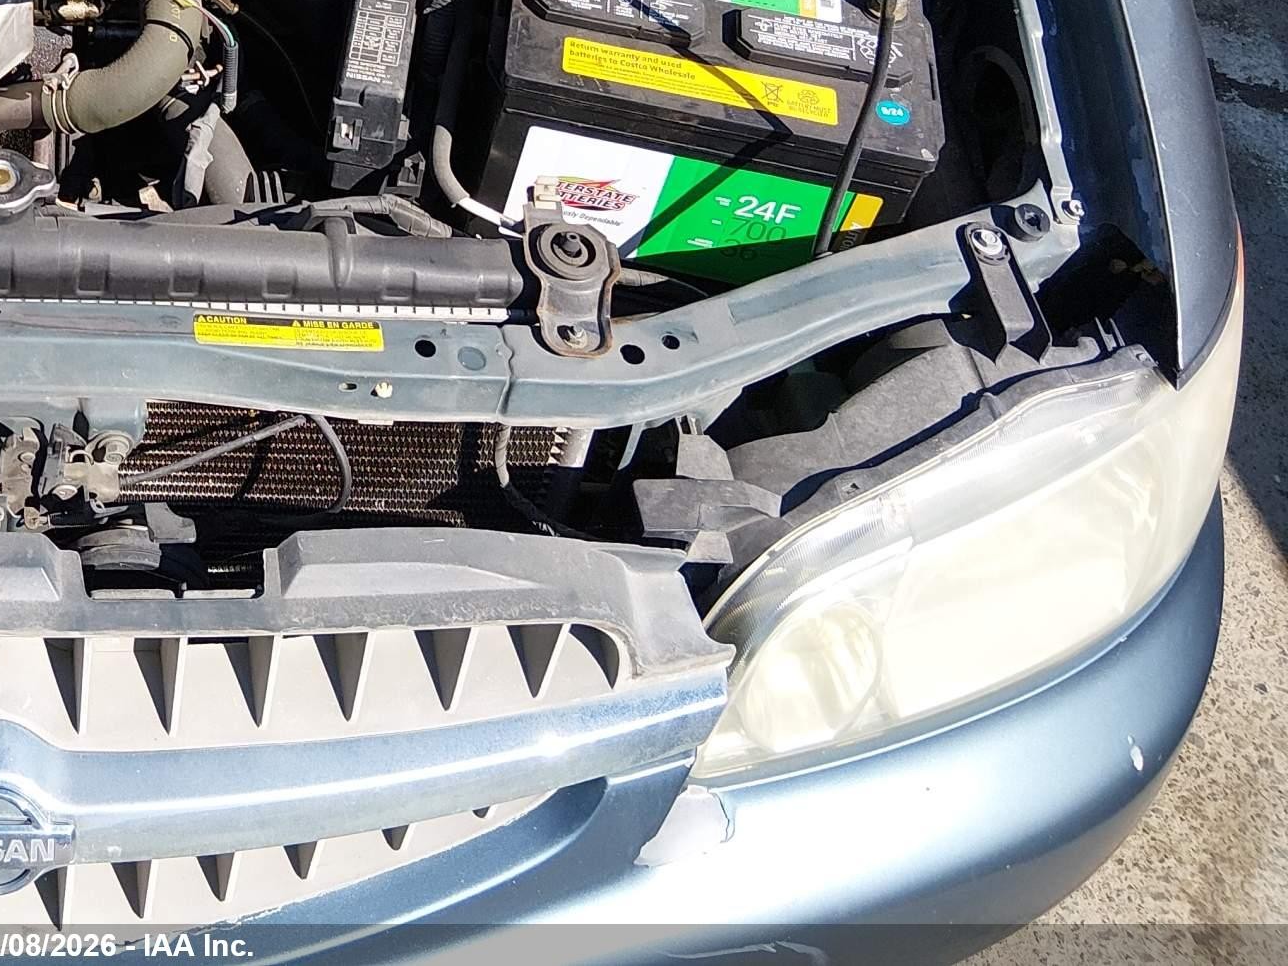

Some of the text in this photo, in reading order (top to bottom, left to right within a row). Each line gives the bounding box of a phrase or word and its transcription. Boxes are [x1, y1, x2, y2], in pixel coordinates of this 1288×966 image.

[569, 49, 696, 80] batteries to Costco Wholesale
[570, 40, 683, 69] Return warranty and used
[579, 213, 622, 226] Dependable
[734, 195, 801, 224] 24F
[728, 216, 787, 242] 700
[206, 315, 247, 325] CAUTION
[303, 320, 375, 330] MISE EN GARDE
